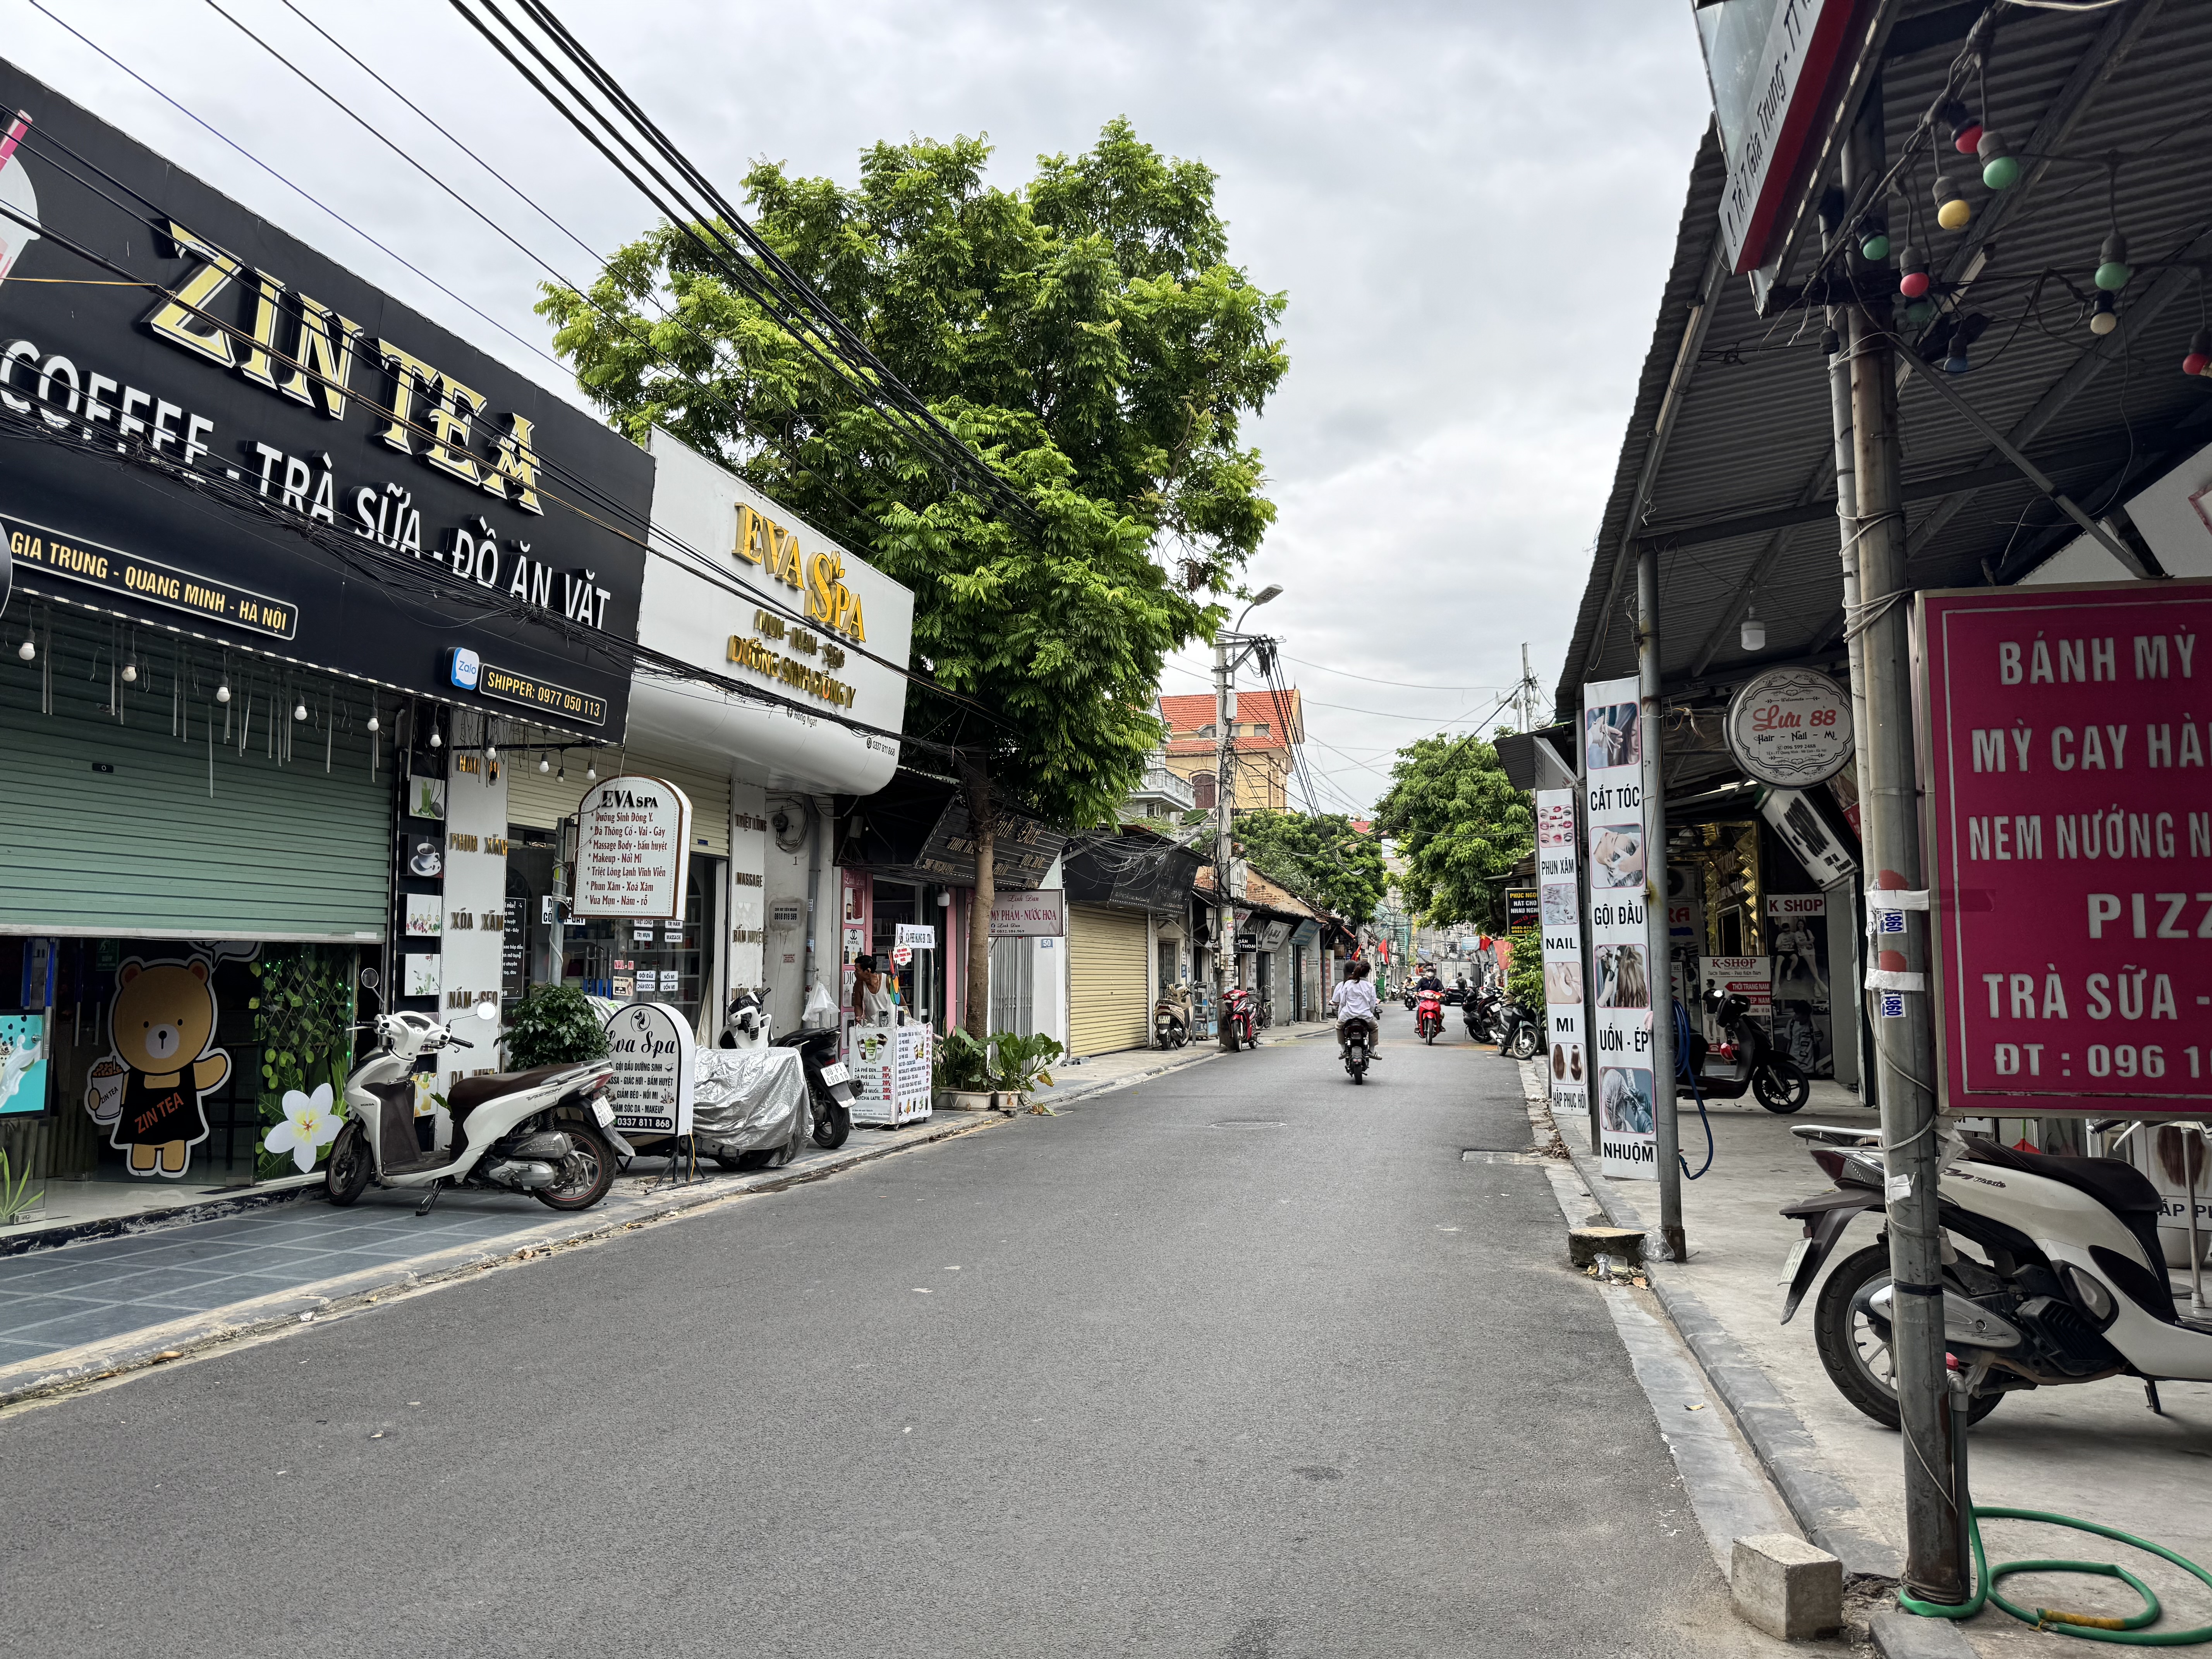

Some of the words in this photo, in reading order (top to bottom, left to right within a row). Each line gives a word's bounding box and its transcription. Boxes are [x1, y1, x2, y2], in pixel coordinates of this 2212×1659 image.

[1747, 132, 1762, 179] Gia
[1757, 58, 1786, 140] Trung
[149, 219, 364, 421] ZIN
[376, 337, 544, 516] TEA
[1, 340, 214, 483] COFFEE
[256, 440, 334, 525] TRÀ
[354, 482, 421, 559] SỮA
[452, 515, 498, 588] ĐỒ
[509, 540, 553, 608] ĂN
[733, 502, 805, 591] EVA
[11, 531, 42, 560] GIA
[50, 542, 108, 579] TRUNG
[125, 566, 180, 600] QUANG
[184, 584, 226, 613] MINH
[239, 599, 258, 623] HÀ
[263, 606, 287, 634] NỘI
[1999, 630, 2116, 685] BÁNH
[2133, 624, 2196, 681] MỲ
[458, 660, 477, 675] Zalo
[487, 671, 535, 699] SHIPPER:
[538, 686, 562, 706] 0977
[564, 696, 582, 713] 050
[584, 699, 600, 718] 113
[1752, 704, 1802, 732] Lưu
[1809, 709, 1837, 728] 88
[1753, 733, 1775, 745] Hair
[1791, 730, 1808, 742] Nail
[1971, 718, 2033, 774] MỲ
[2051, 724, 2128, 771] CAY
[2147, 712, 2212, 769] HÀ
[601, 790, 635, 808] EVA
[636, 796, 659, 808] SPA
[1590, 784, 1613, 812] CẮT
[1618, 783, 1640, 807] TÓC
[617, 812, 630, 822] Sinh
[631, 813, 647, 824] Đông
[605, 826, 623, 838] Thông
[624, 824, 634, 836] Cổ
[638, 826, 648, 836] Vai
[653, 826, 666, 838] Gáy
[1968, 813, 2043, 861] NEM
[2055, 803, 2175, 860] NƯỚNG
[593, 840, 617, 851] Massage
[618, 840, 633, 851] Body
[637, 839, 650, 850] bấm
[651, 840, 668, 852] huyệt
[592, 852, 616, 865] Makeup
[1541, 860, 1559, 876] PHUN
[1560, 857, 1575, 874] XĂM
[592, 866, 606, 878] Triệt
[607, 866, 621, 878] Lông
[623, 866, 636, 878] Lạnh
[735, 872, 763, 888] MASSAGE
[590, 881, 605, 891] Phun
[626, 881, 638, 891] Xoá
[589, 895, 601, 905] Vua
[602, 895, 615, 907] Mụn
[621, 895, 635, 905] Nám
[1769, 900, 1779, 912] K
[1784, 898, 1823, 912] SHOP
[1024, 907, 1041, 921] NƯỚC
[1042, 909, 1056, 921] HOA
[1594, 902, 1616, 930] GỘI
[1618, 899, 1643, 925] ĐẦU
[1546, 937, 1577, 950] NAIL
[1711, 958, 1757, 969] K-SHOP
[1982, 963, 2068, 1020] TRÀ
[2086, 963, 2178, 1021] SỮA
[1556, 1018, 1574, 1032] MI
[641, 1030, 676, 1059] Spa
[1599, 1023, 1623, 1052] UỐN
[1634, 1026, 1649, 1053] ÉP
[651, 1063, 663, 1072] SINH
[1993, 1042, 2045, 1076] ĐT
[2086, 1044, 2165, 1078] 096
[2183, 1046, 2212, 1079] 1
[825, 1065, 843, 1076] 88-F1
[623, 1075, 635, 1085] GIÁC
[635, 1076, 644, 1085] HƠI
[647, 1074, 658, 1086] BẤM
[659, 1076, 673, 1088] HUYỆT
[108, 1086, 119, 1100] TEA
[617, 1087, 629, 1099] GIẢM
[643, 1088, 651, 1099] NỐI
[652, 1091, 658, 1099] MI
[1552, 1089, 1563, 1108] HẤP
[1563, 1092, 1577, 1112] PHỤC
[1578, 1087, 1587, 1109] HỒI
[134, 1108, 159, 1134] ZIN
[157, 1092, 184, 1118] TEA
[624, 1103, 634, 1113] SÓC
[644, 1105, 665, 1114] MAKEUP
[617, 1118, 637, 1127] 0337
[638, 1118, 653, 1127] 811
[655, 1119, 670, 1128] 868
[1603, 1141, 1654, 1164] NHUỘM
[2159, 1198, 2185, 1217] ẤP
